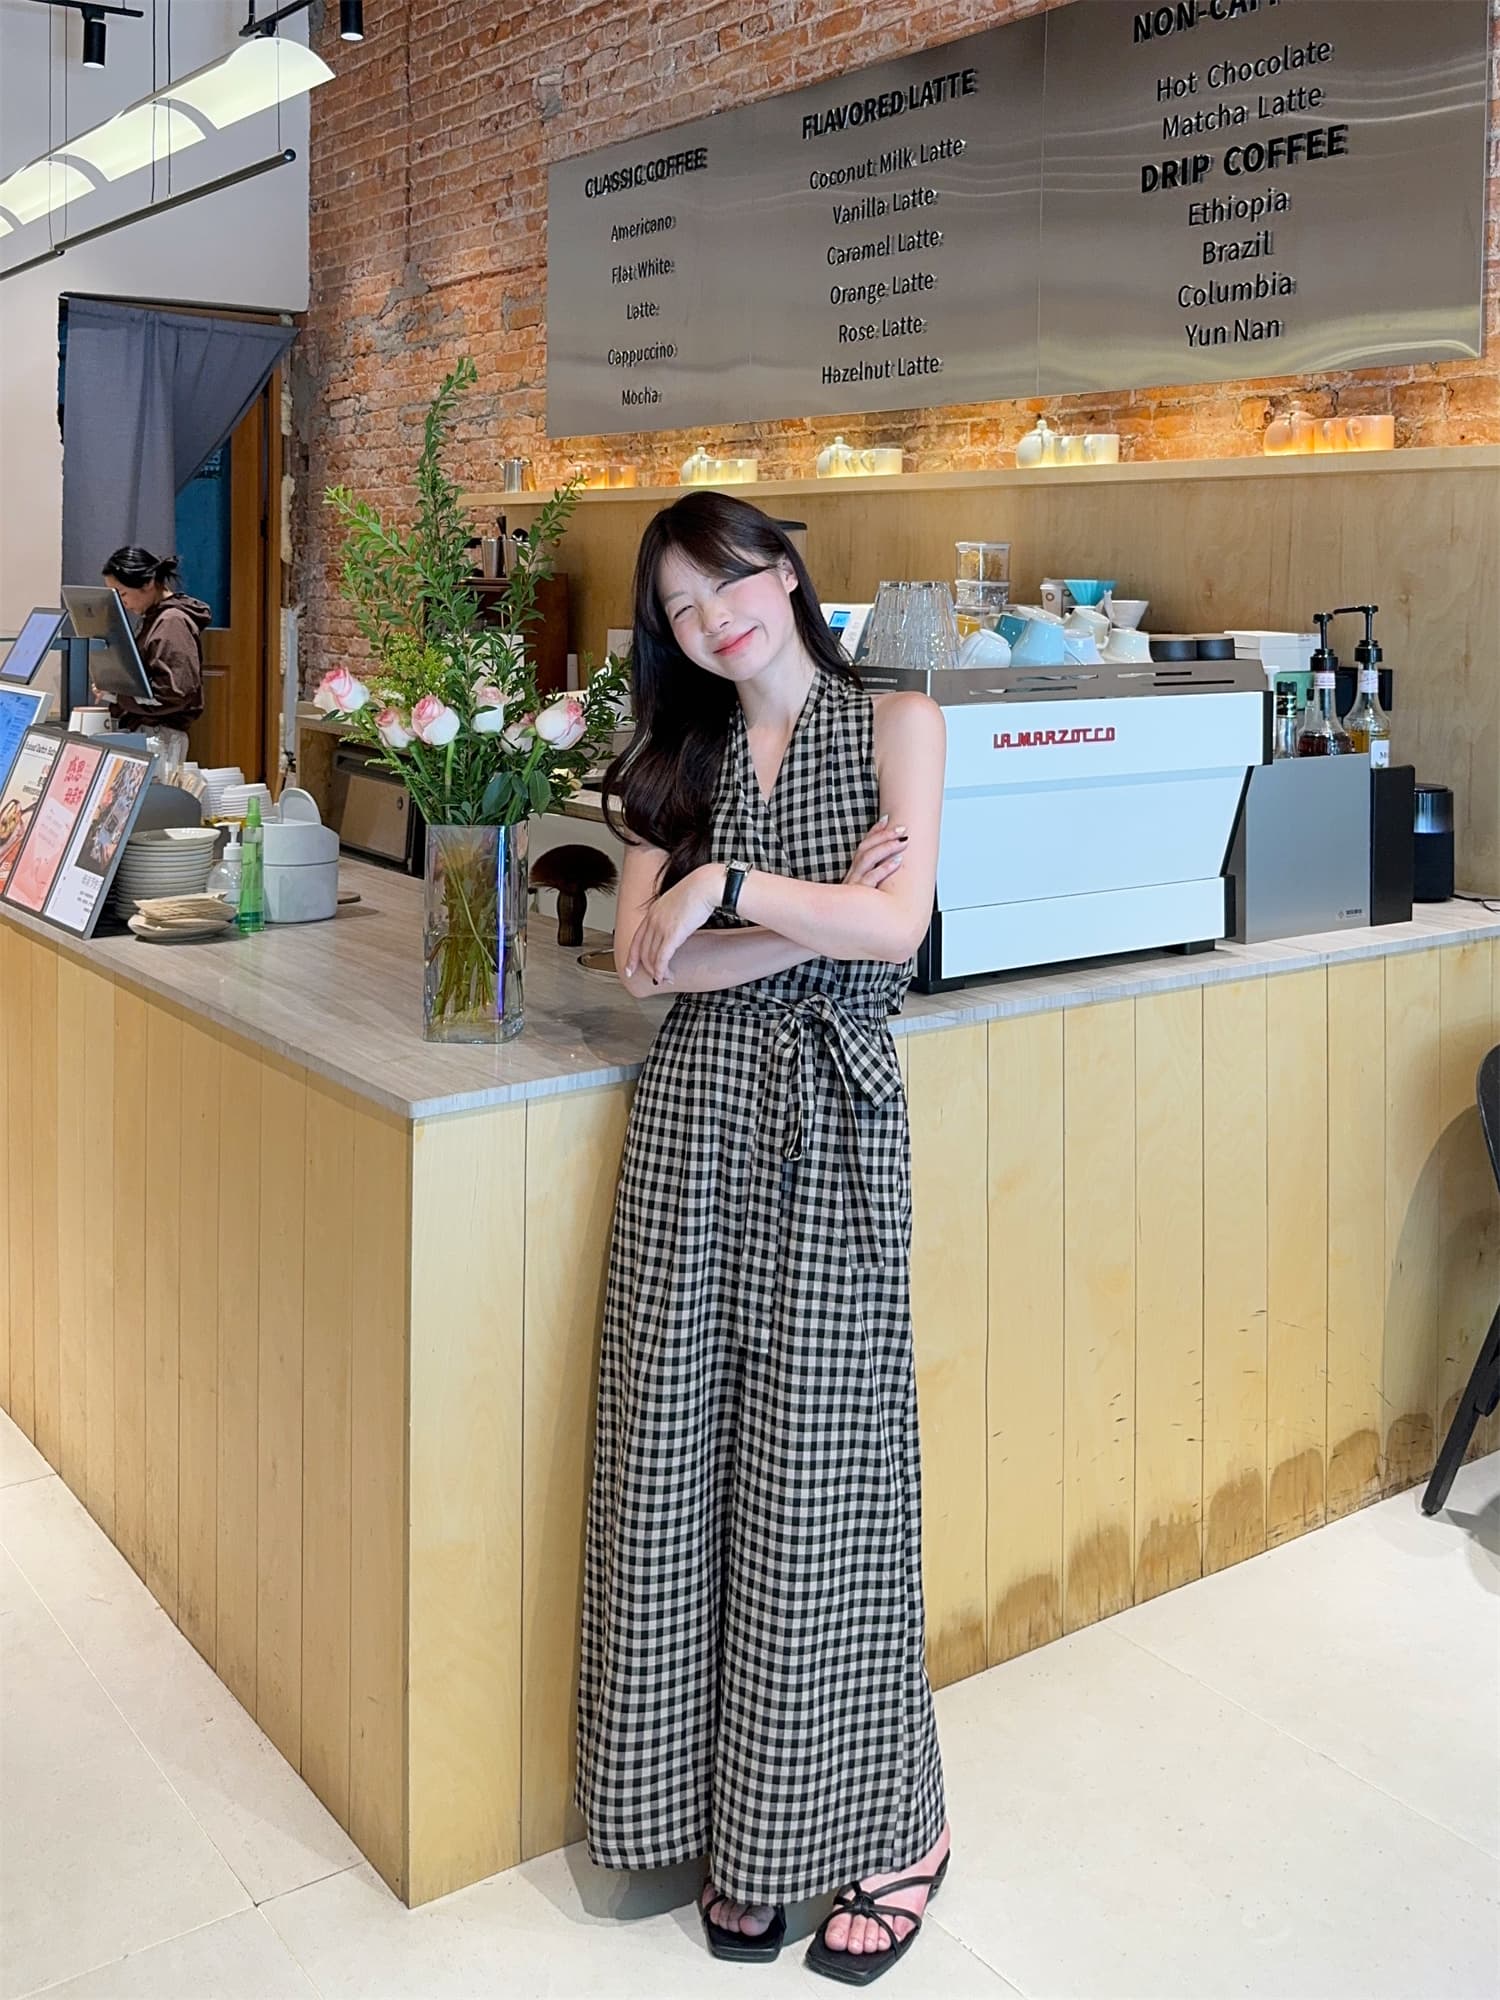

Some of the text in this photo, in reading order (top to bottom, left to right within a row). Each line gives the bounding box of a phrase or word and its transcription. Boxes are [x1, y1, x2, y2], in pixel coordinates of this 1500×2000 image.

[1157, 42, 1332, 101] Hot Chocolate
[802, 68, 977, 139] FLAVORED LATTE
[1163, 87, 1323, 140] Matcha Latte
[585, 148, 707, 198] CLASSIC COFFEE
[809, 138, 964, 190] Coconut Milk Latte
[1141, 124, 1347, 193] DRIP COFFEE
[833, 187, 935, 224] Vanilla Latte
[1188, 188, 1290, 226] Ethiopia
[611, 216, 673, 241] Americano
[827, 228, 940, 265] Caramel Latte
[1203, 230, 1270, 265] Brazil
[612, 258, 671, 284] Flat White
[830, 272, 935, 305] Orange Latte
[1178, 271, 1294, 309] Columbia
[626, 301, 657, 320] Latte
[839, 315, 924, 343] Rose Latte
[1185, 318, 1282, 347] Yun Nan
[608, 341, 675, 368] Cappuccino
[822, 355, 940, 385] Hazelnut Latte
[622, 386, 659, 406] Mocha
[993, 727, 1116, 749] LA MARZOCCO
